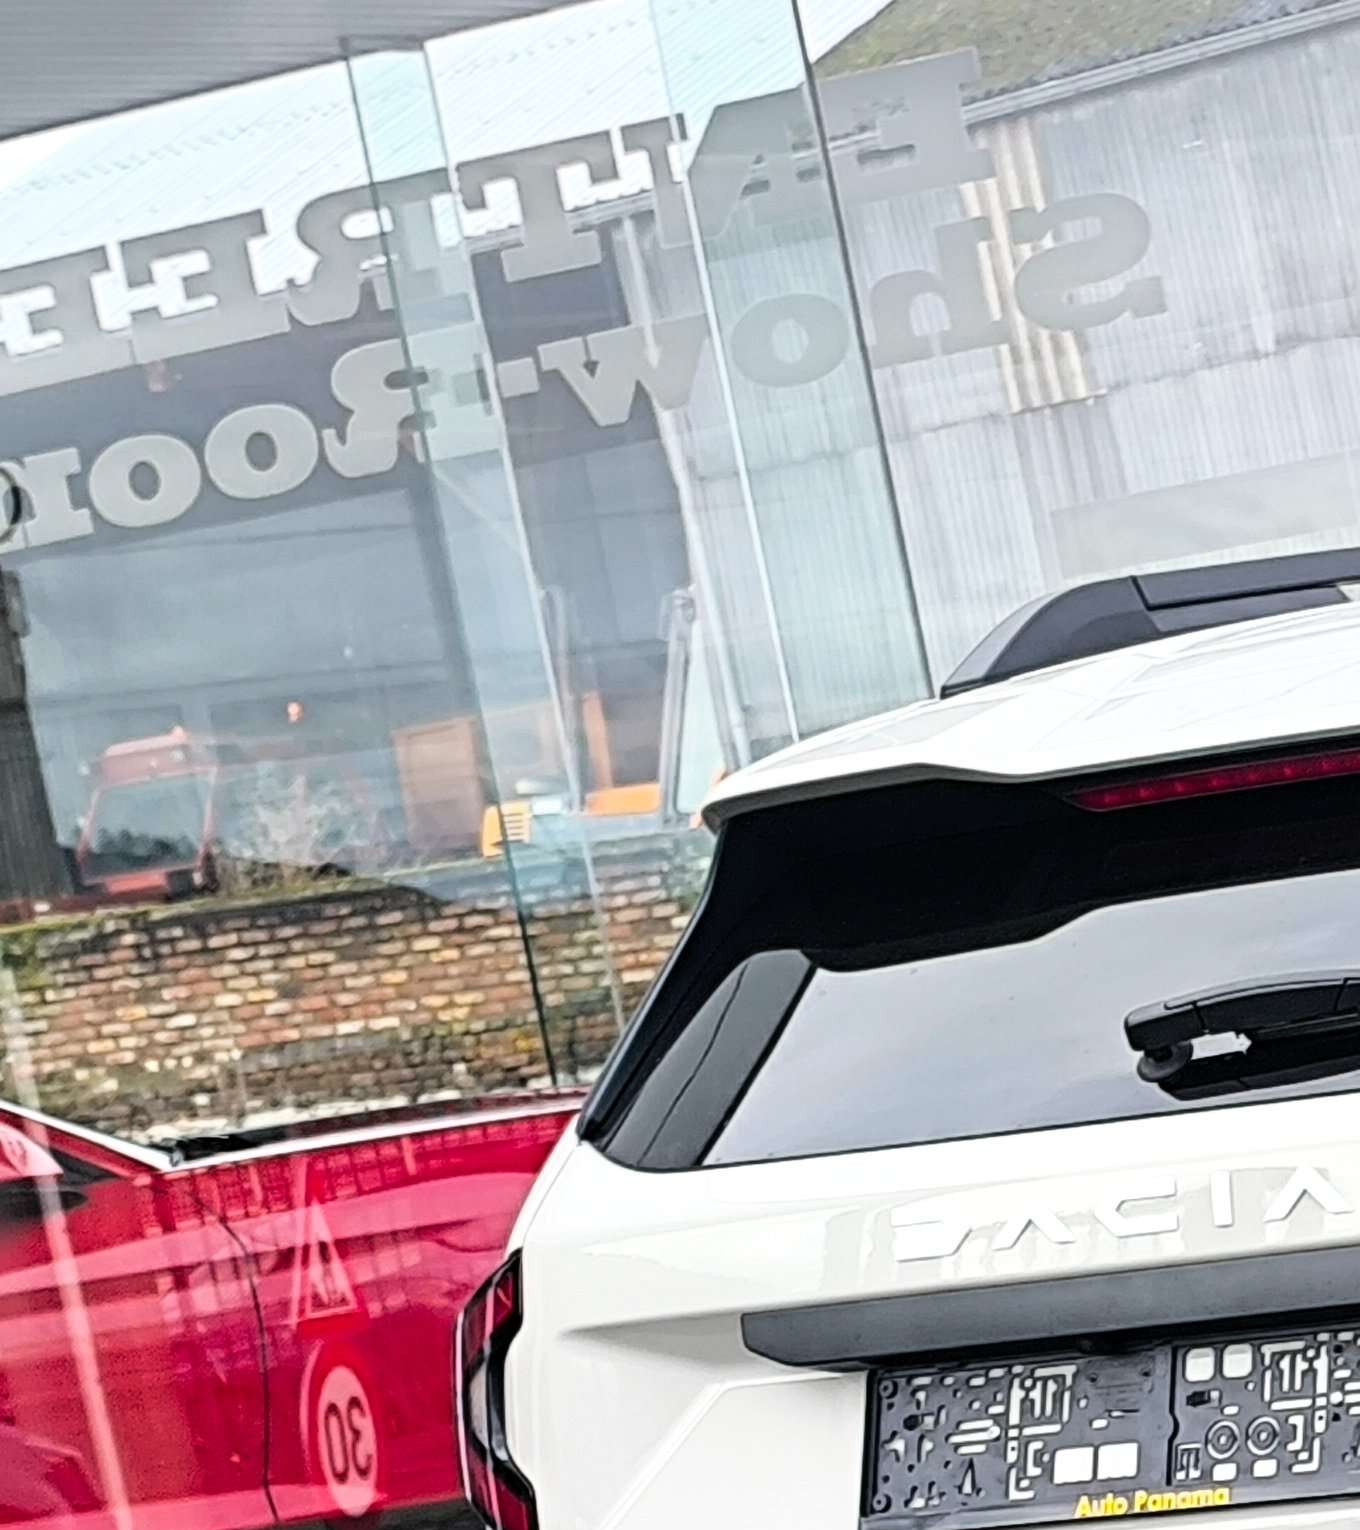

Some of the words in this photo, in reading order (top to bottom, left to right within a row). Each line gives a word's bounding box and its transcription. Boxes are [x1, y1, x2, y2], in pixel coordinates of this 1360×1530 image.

[890, 1166, 1355, 1262] DACIA
[1074, 1492, 1128, 1518] Auto
[1134, 1487, 1231, 1513] Panama
